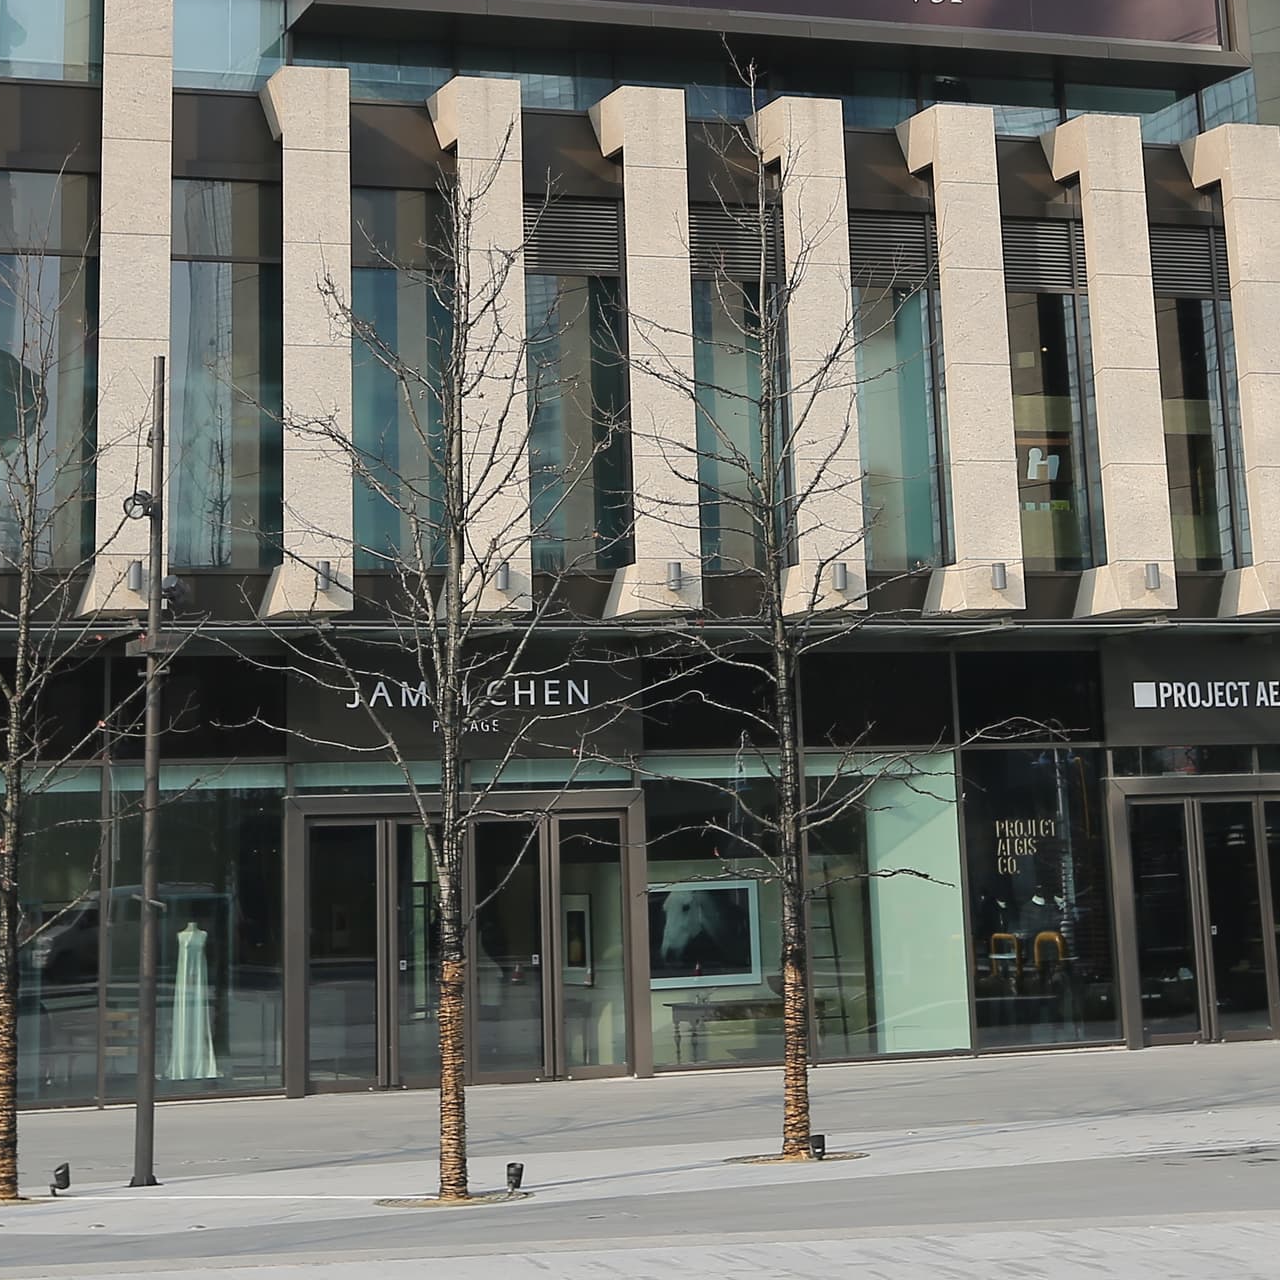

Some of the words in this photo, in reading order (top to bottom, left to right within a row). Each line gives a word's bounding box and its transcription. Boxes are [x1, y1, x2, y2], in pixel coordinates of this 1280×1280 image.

[346, 681, 468, 708] JAMI
[486, 679, 589, 706] CHEN
[1159, 681, 1250, 708] PROJECT
[998, 856, 1020, 875] CO.
